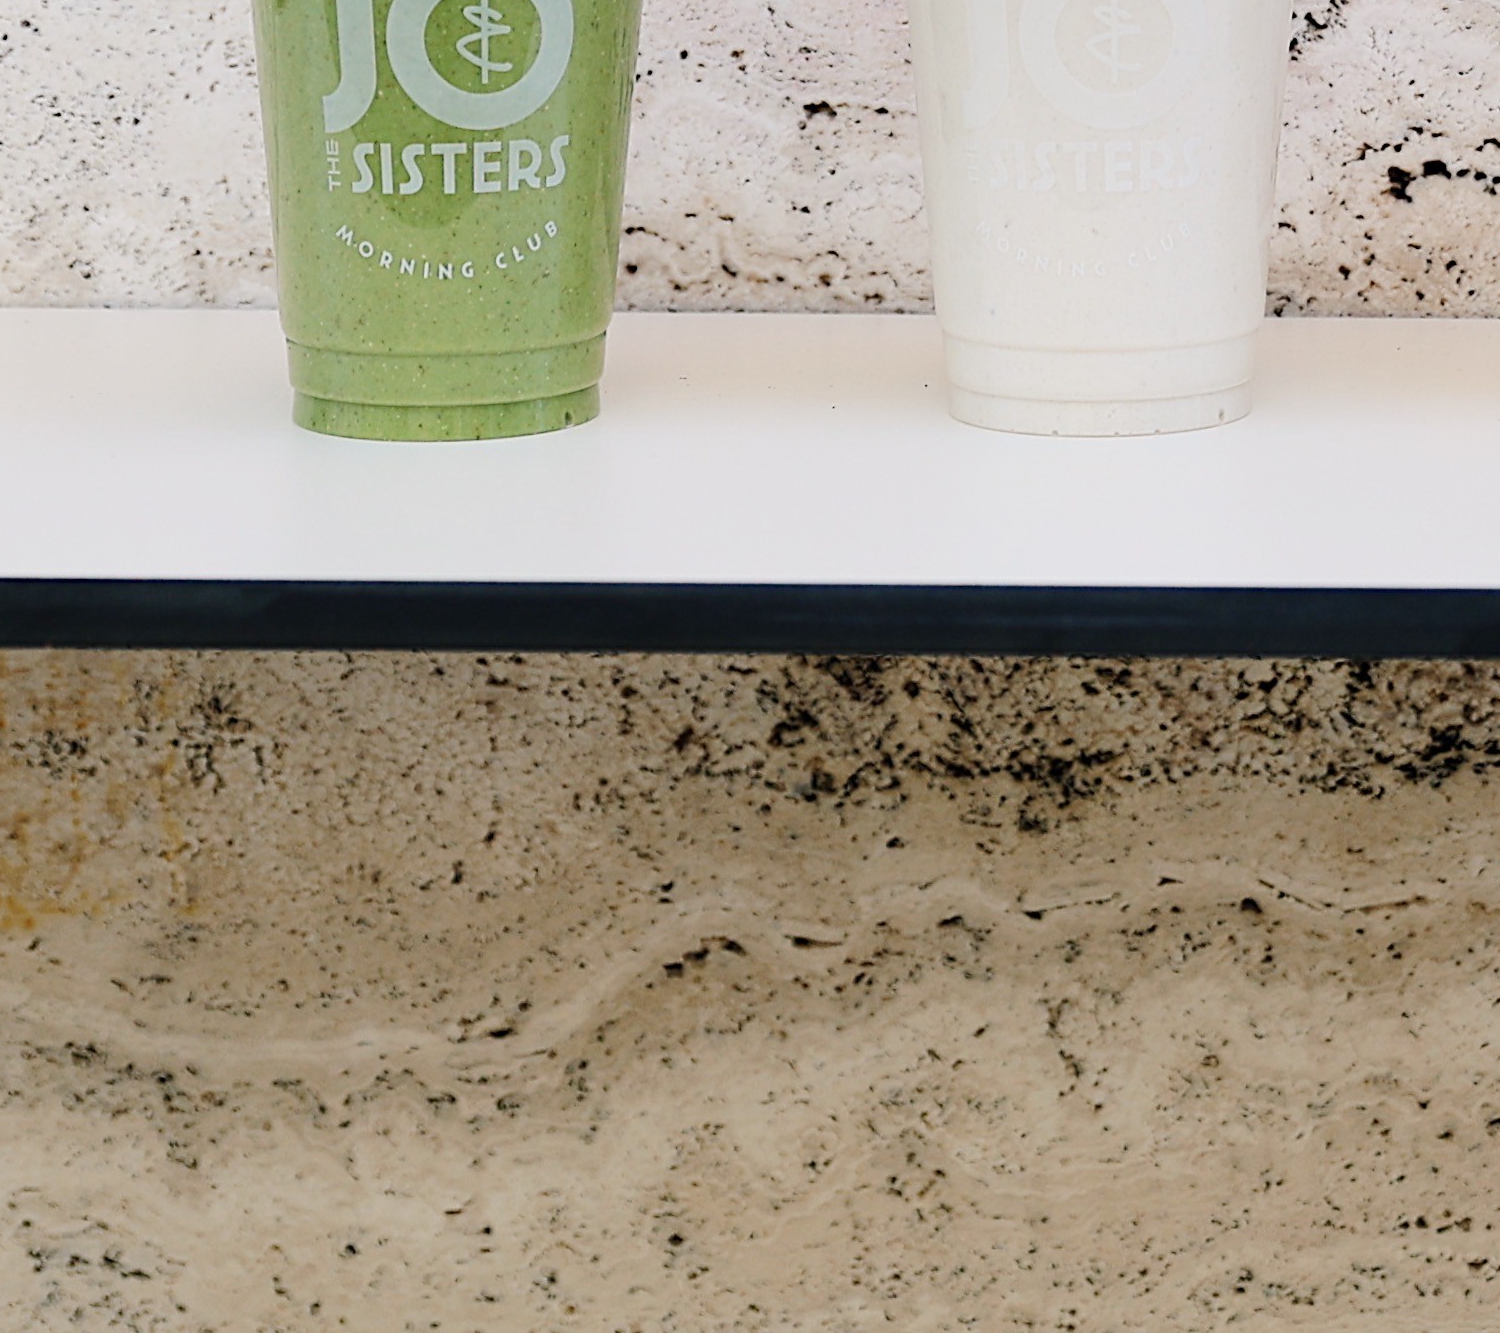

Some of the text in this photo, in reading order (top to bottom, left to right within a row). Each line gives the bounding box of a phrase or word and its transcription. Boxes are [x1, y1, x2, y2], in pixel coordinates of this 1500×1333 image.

[326, 135, 569, 195] THE SISTERS
[336, 220, 558, 280] MORNING CLUB
